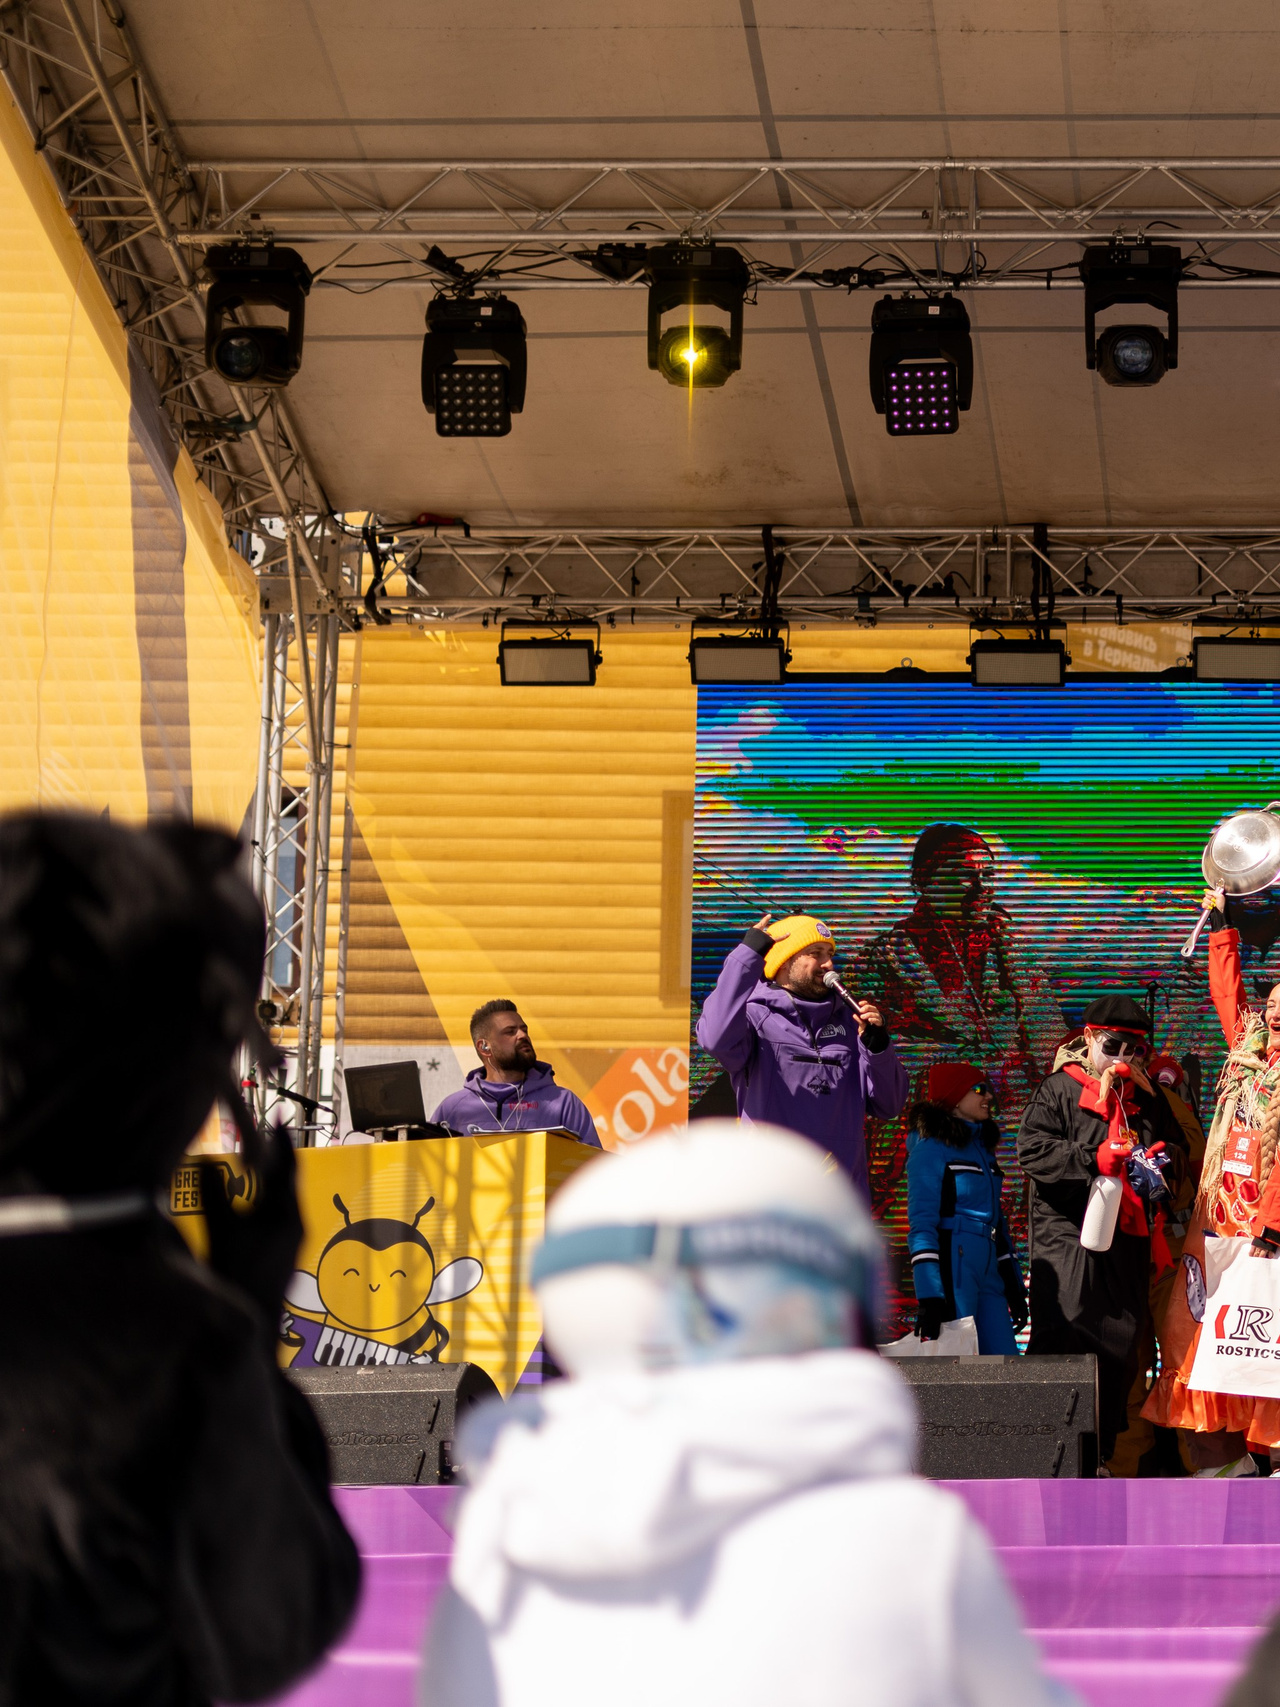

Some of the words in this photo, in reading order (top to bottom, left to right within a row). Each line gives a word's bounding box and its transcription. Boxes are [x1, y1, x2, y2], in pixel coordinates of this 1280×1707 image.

[1233, 1151, 1247, 1160] 124
[174, 1170, 200, 1189] GRE
[173, 1190, 199, 1209] FES
[327, 1430, 420, 1447] oTone
